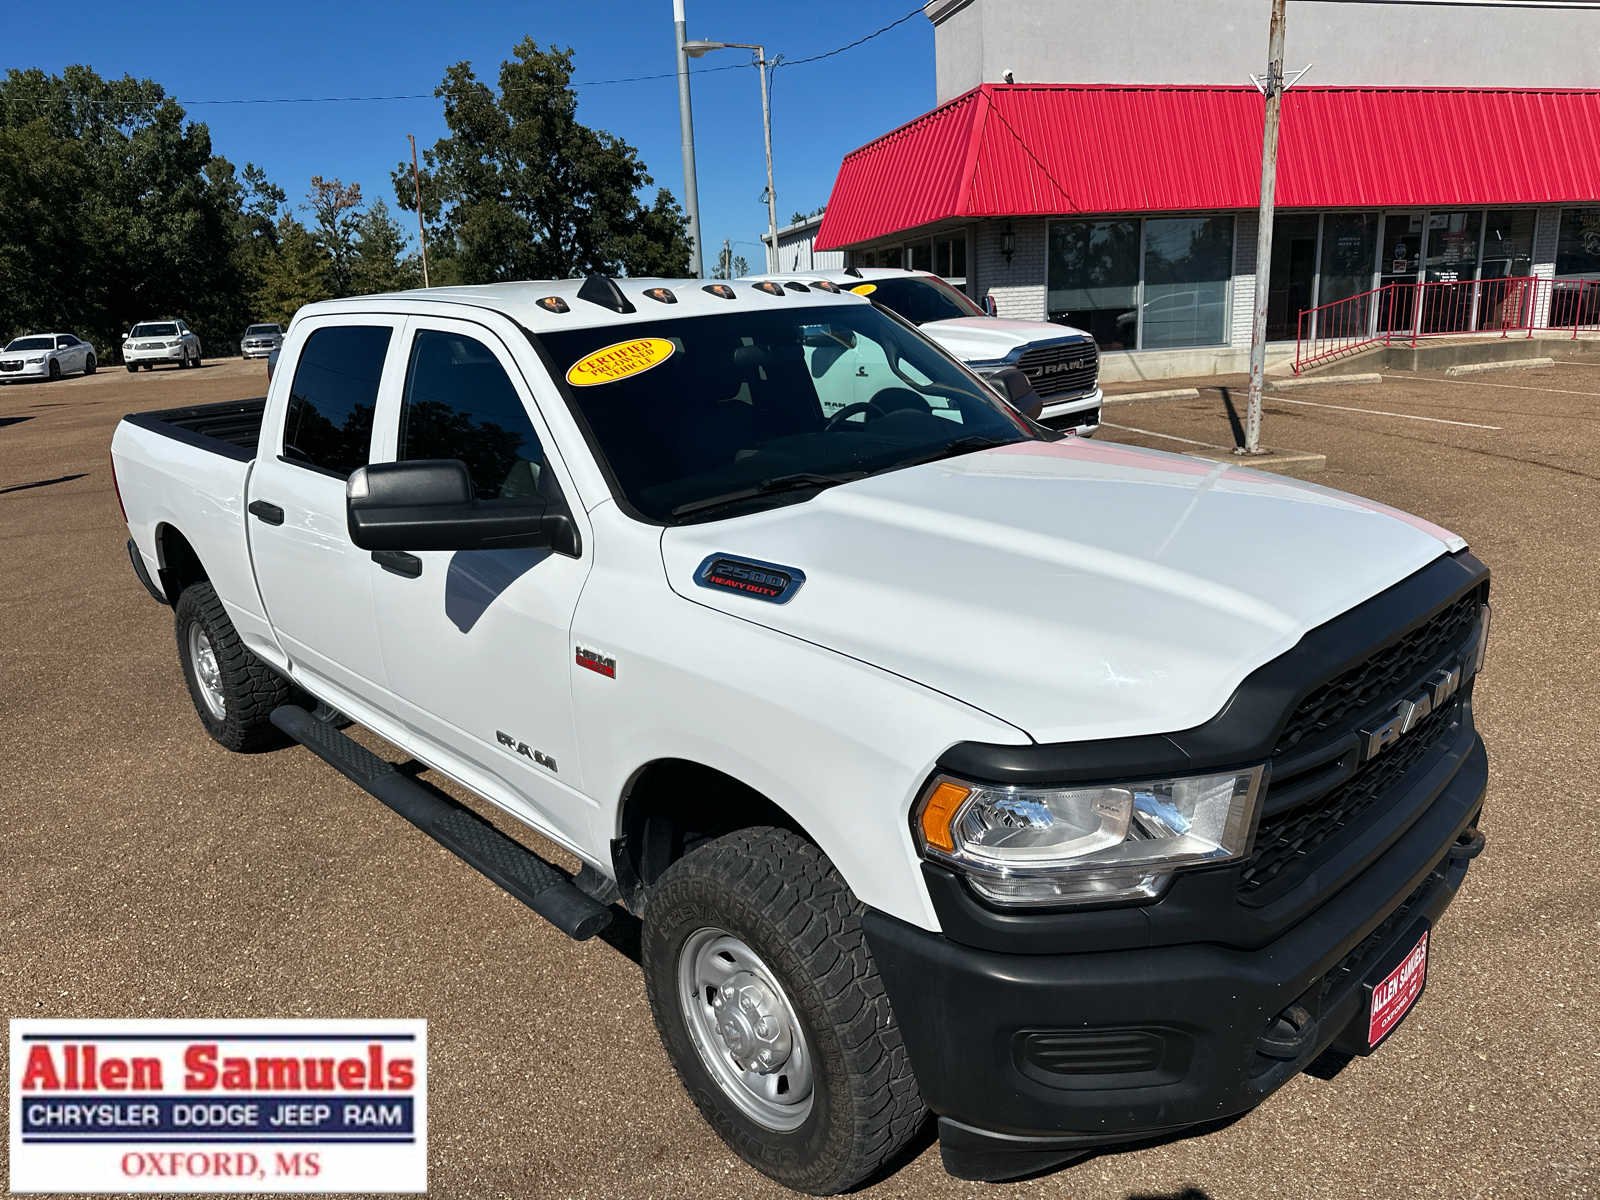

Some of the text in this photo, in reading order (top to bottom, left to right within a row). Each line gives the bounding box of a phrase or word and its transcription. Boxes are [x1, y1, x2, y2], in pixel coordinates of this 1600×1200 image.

[577, 341, 653, 372] CERTIFIED
[605, 357, 654, 377] VEHICLE
[1044, 359, 1085, 374] RAM
[823, 401, 846, 409] RAM
[710, 575, 777, 597] HEAVY DUTY
[716, 563, 784, 587] 2500
[1361, 665, 1461, 761] RAM
[496, 729, 559, 773] RAM
[1373, 938, 1427, 1014] ALLEN SAMUELS
[1381, 995, 1408, 1027] OXFORD
